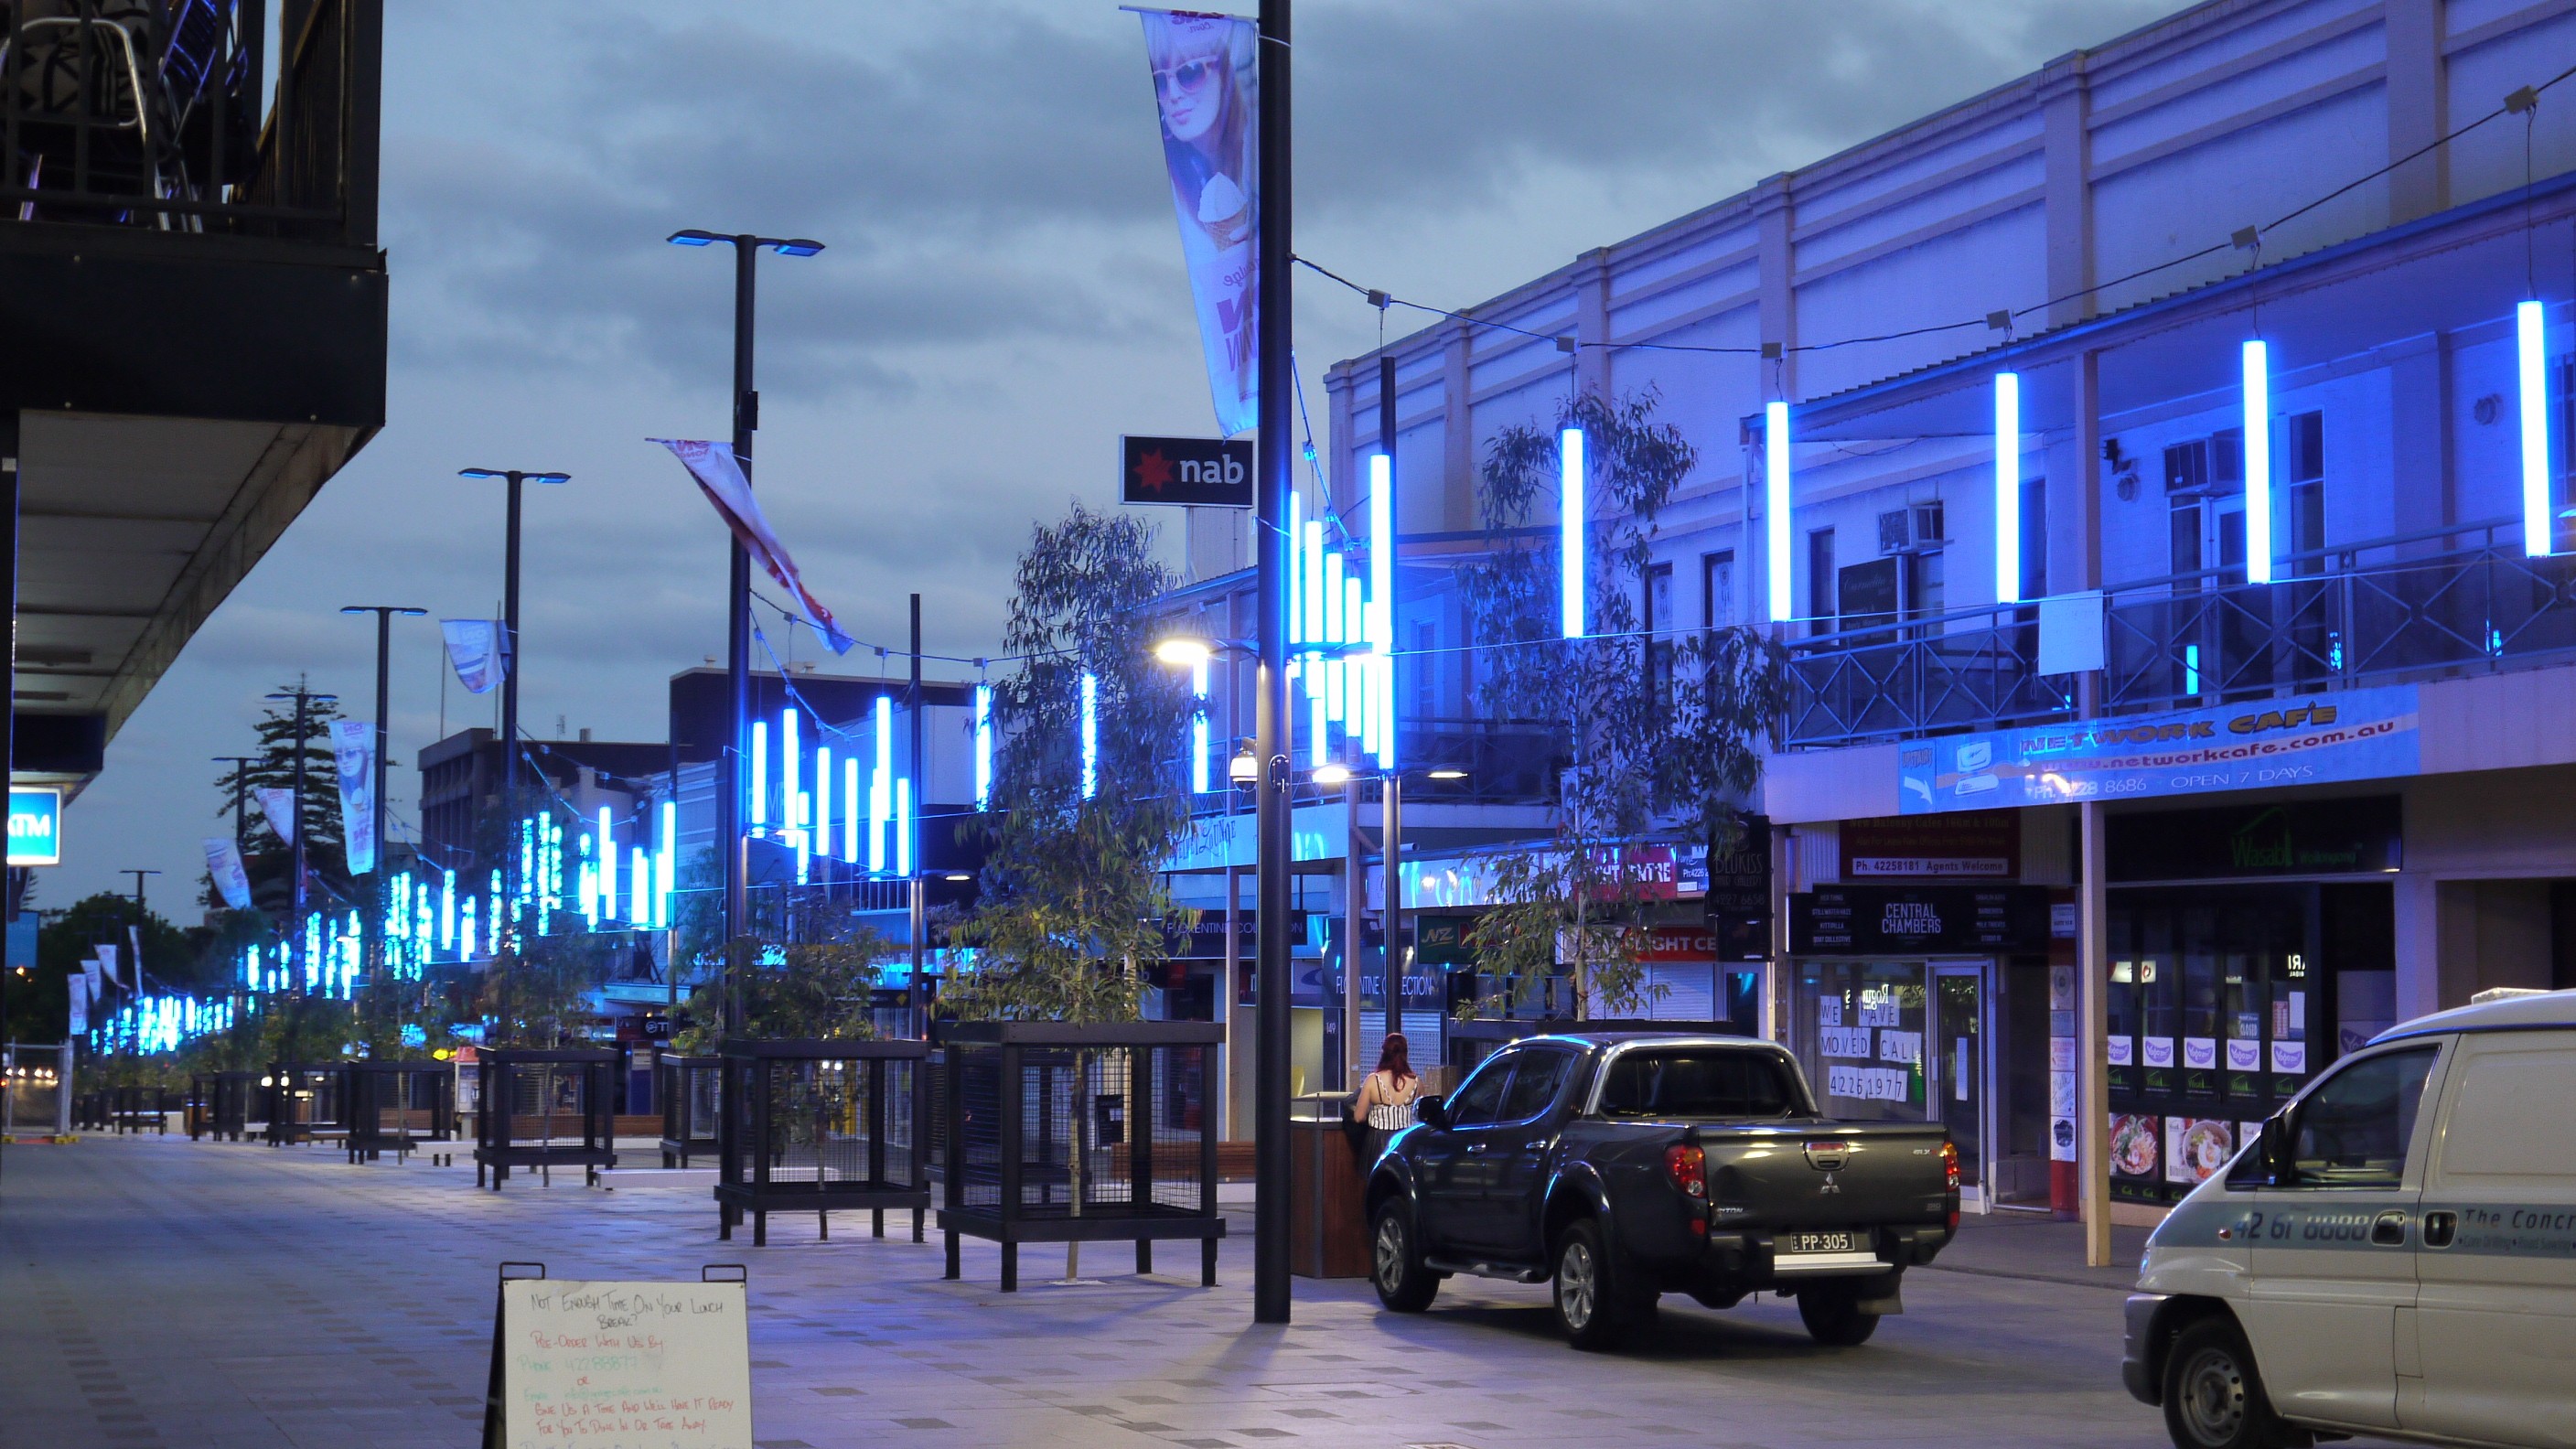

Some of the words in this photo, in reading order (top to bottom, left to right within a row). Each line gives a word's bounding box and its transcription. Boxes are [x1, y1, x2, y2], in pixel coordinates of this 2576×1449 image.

[1180, 454, 1244, 484] nab
[2020, 719, 2216, 754] NETWORK
[2041, 721, 2395, 774] www.networkcafe.com.au
[2105, 778, 2147, 794] 8686
[2171, 773, 2229, 789] OPEN
[2239, 770, 2249, 783] 7
[2259, 765, 2313, 782] DAYS
[1622, 863, 1671, 883] ENTRE
[1856, 861, 1869, 872] Ph.
[1873, 861, 1920, 872] 42258181
[1926, 861, 1959, 873] Agents
[1962, 861, 2003, 872] Welcome
[1885, 903, 1937, 919] CENTRAL
[1166, 922, 1227, 934] FORENTINE
[1882, 918, 1942, 934] CHAMBERS
[1336, 976, 1379, 995] FLONTINE
[1382, 976, 1433, 996] CECTION
[1821, 1004, 1839, 1023] WE
[1861, 997, 1895, 1024] HAVE
[1821, 1036, 1868, 1055] MOVED
[1881, 1040, 1917, 1060] CALL
[1830, 1076, 1903, 1098] 42261977
[2235, 1212, 2263, 1240] 42
[2465, 1209, 2501, 1223] The
[2512, 1209, 2576, 1230] Concr
